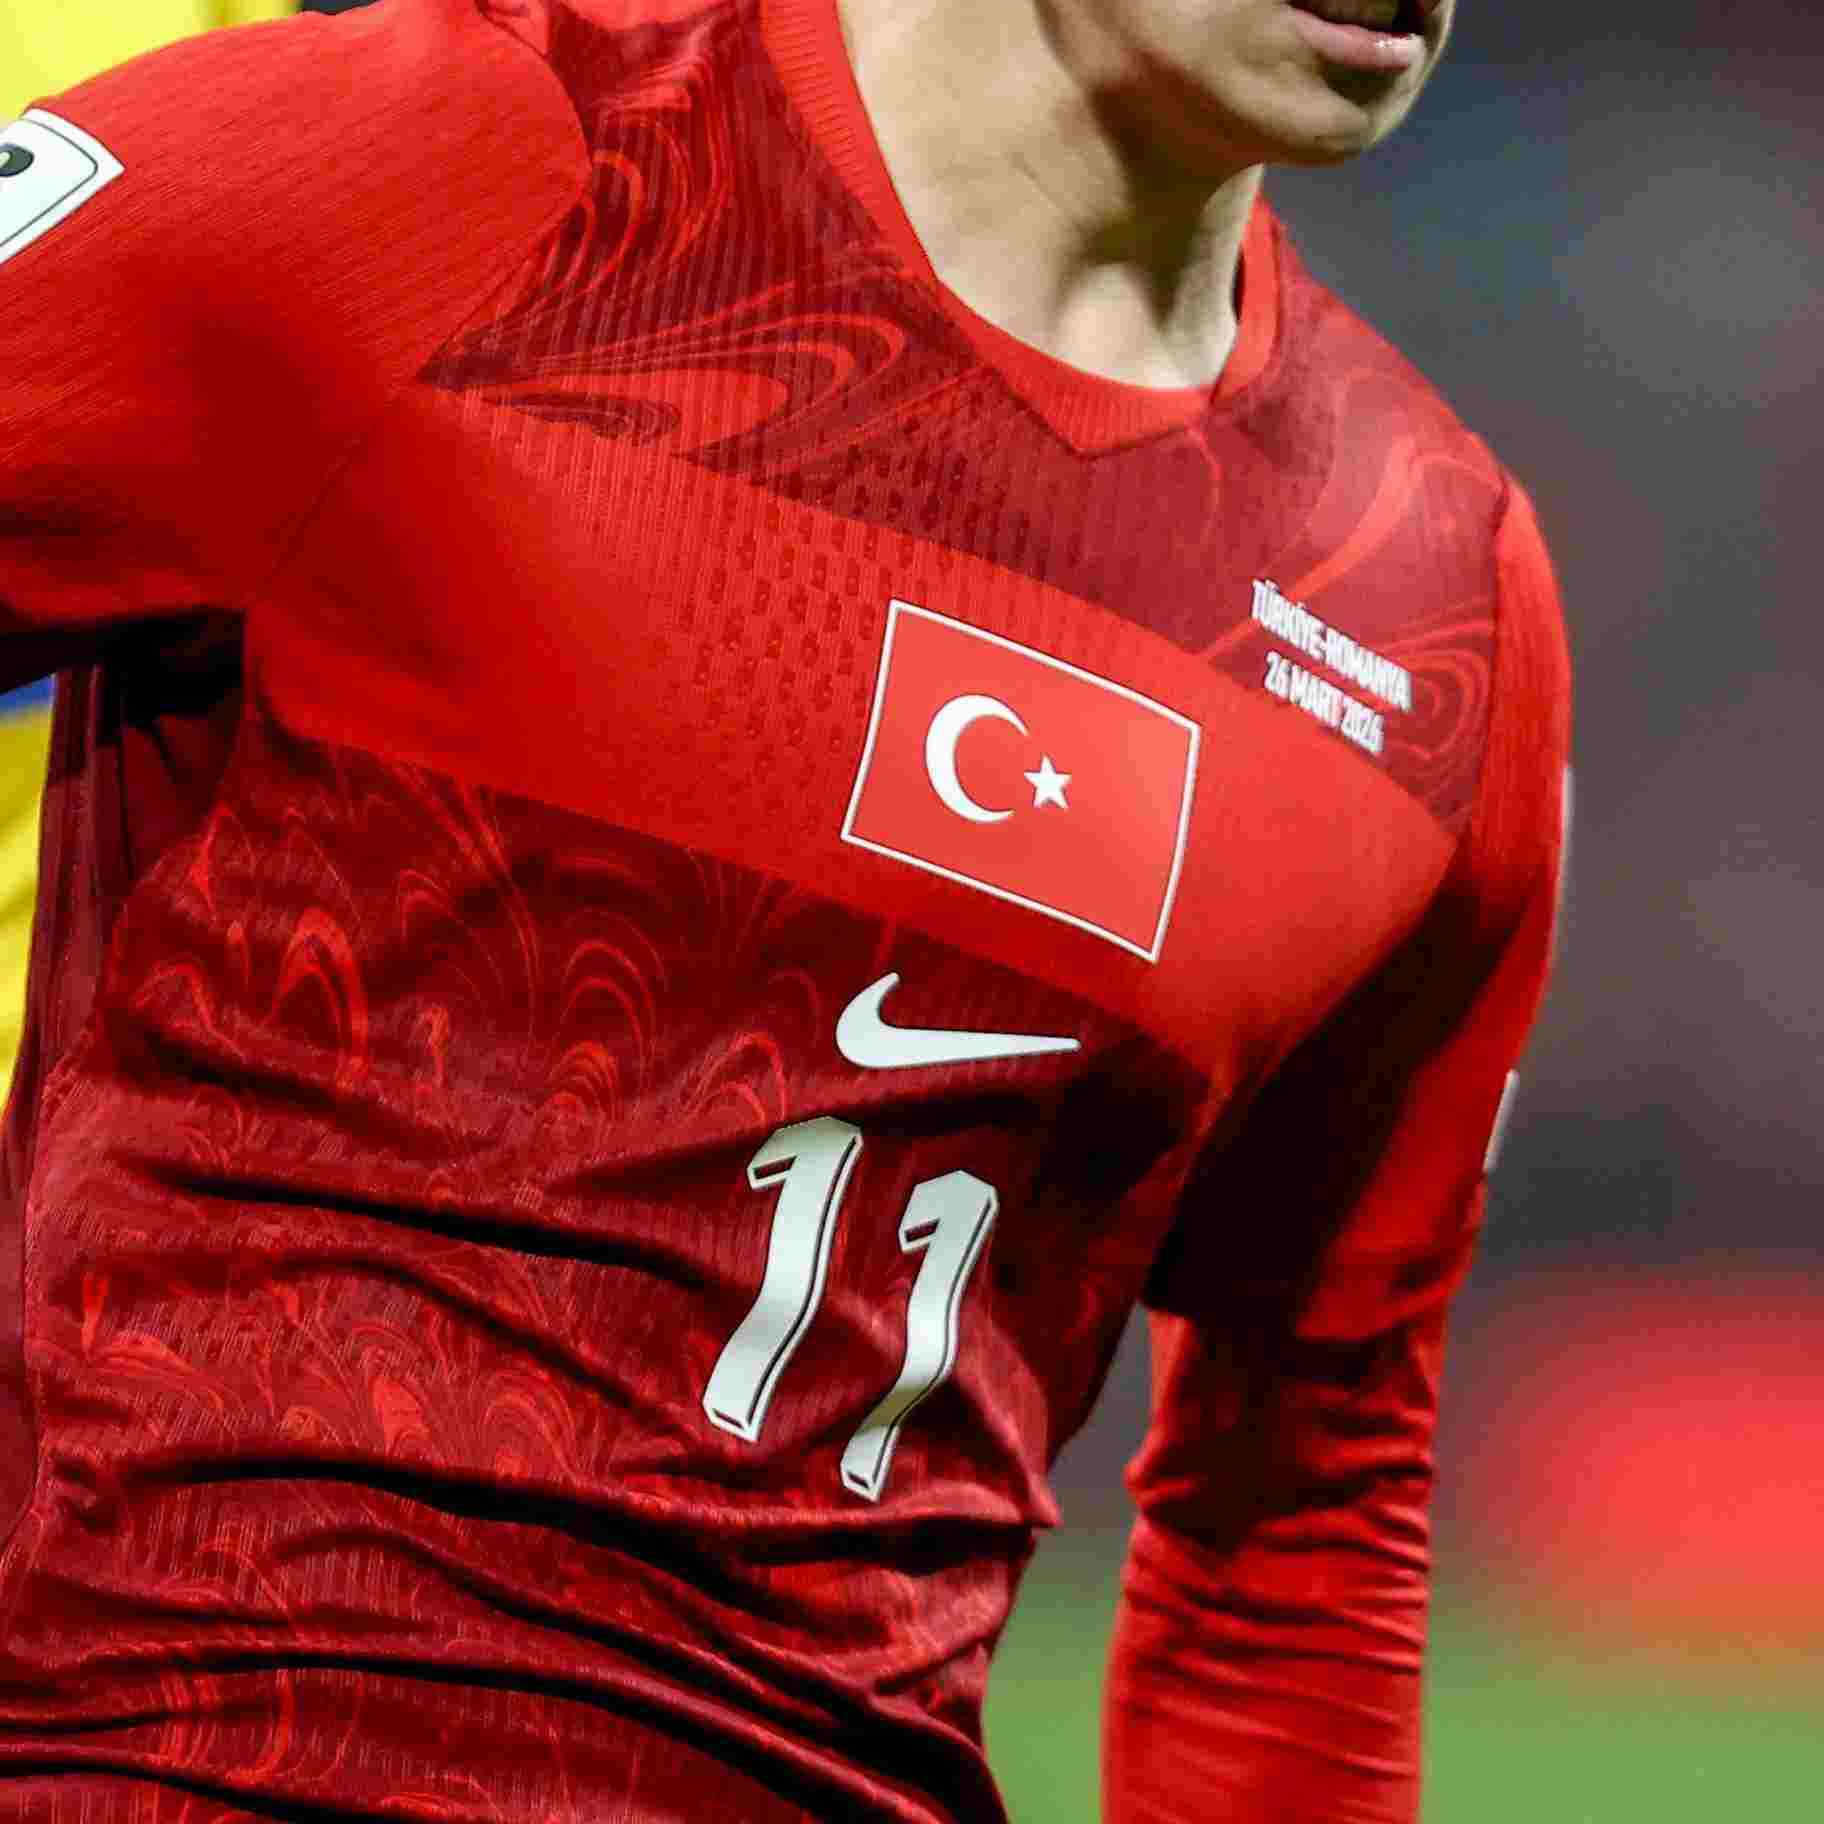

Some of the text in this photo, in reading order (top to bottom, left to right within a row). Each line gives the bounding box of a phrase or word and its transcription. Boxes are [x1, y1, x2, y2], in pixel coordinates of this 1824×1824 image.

[1264, 650, 1291, 701] 26
[1289, 663, 1345, 730] MART
[702, 1115, 1000, 1502] 11
